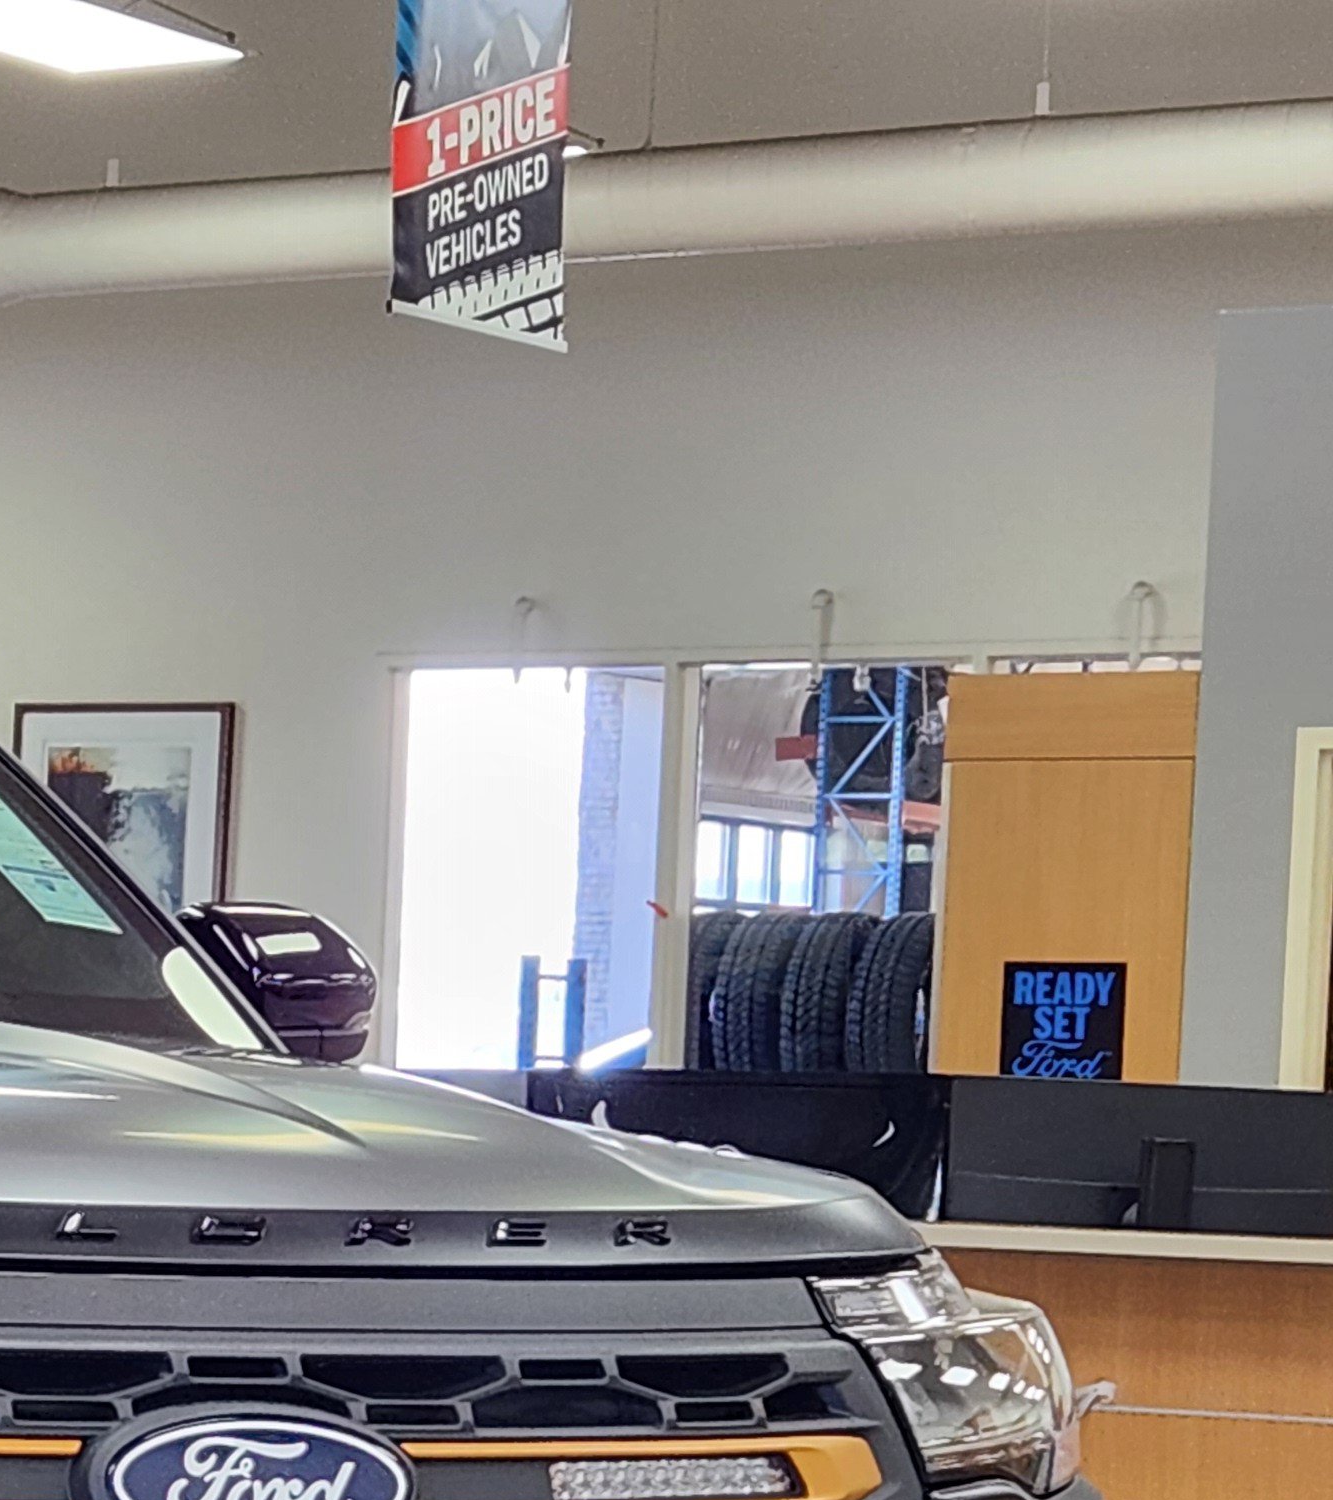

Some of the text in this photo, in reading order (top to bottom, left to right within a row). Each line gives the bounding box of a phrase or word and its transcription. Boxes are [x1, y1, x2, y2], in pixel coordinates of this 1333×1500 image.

[427, 77, 556, 178] 1-PRICE
[427, 152, 549, 232] PRE-OWNED
[426, 208, 522, 279] VEHICLES
[1013, 971, 1116, 1006] READY
[1033, 1006, 1090, 1040] SET
[1011, 1040, 1106, 1078] Ford
